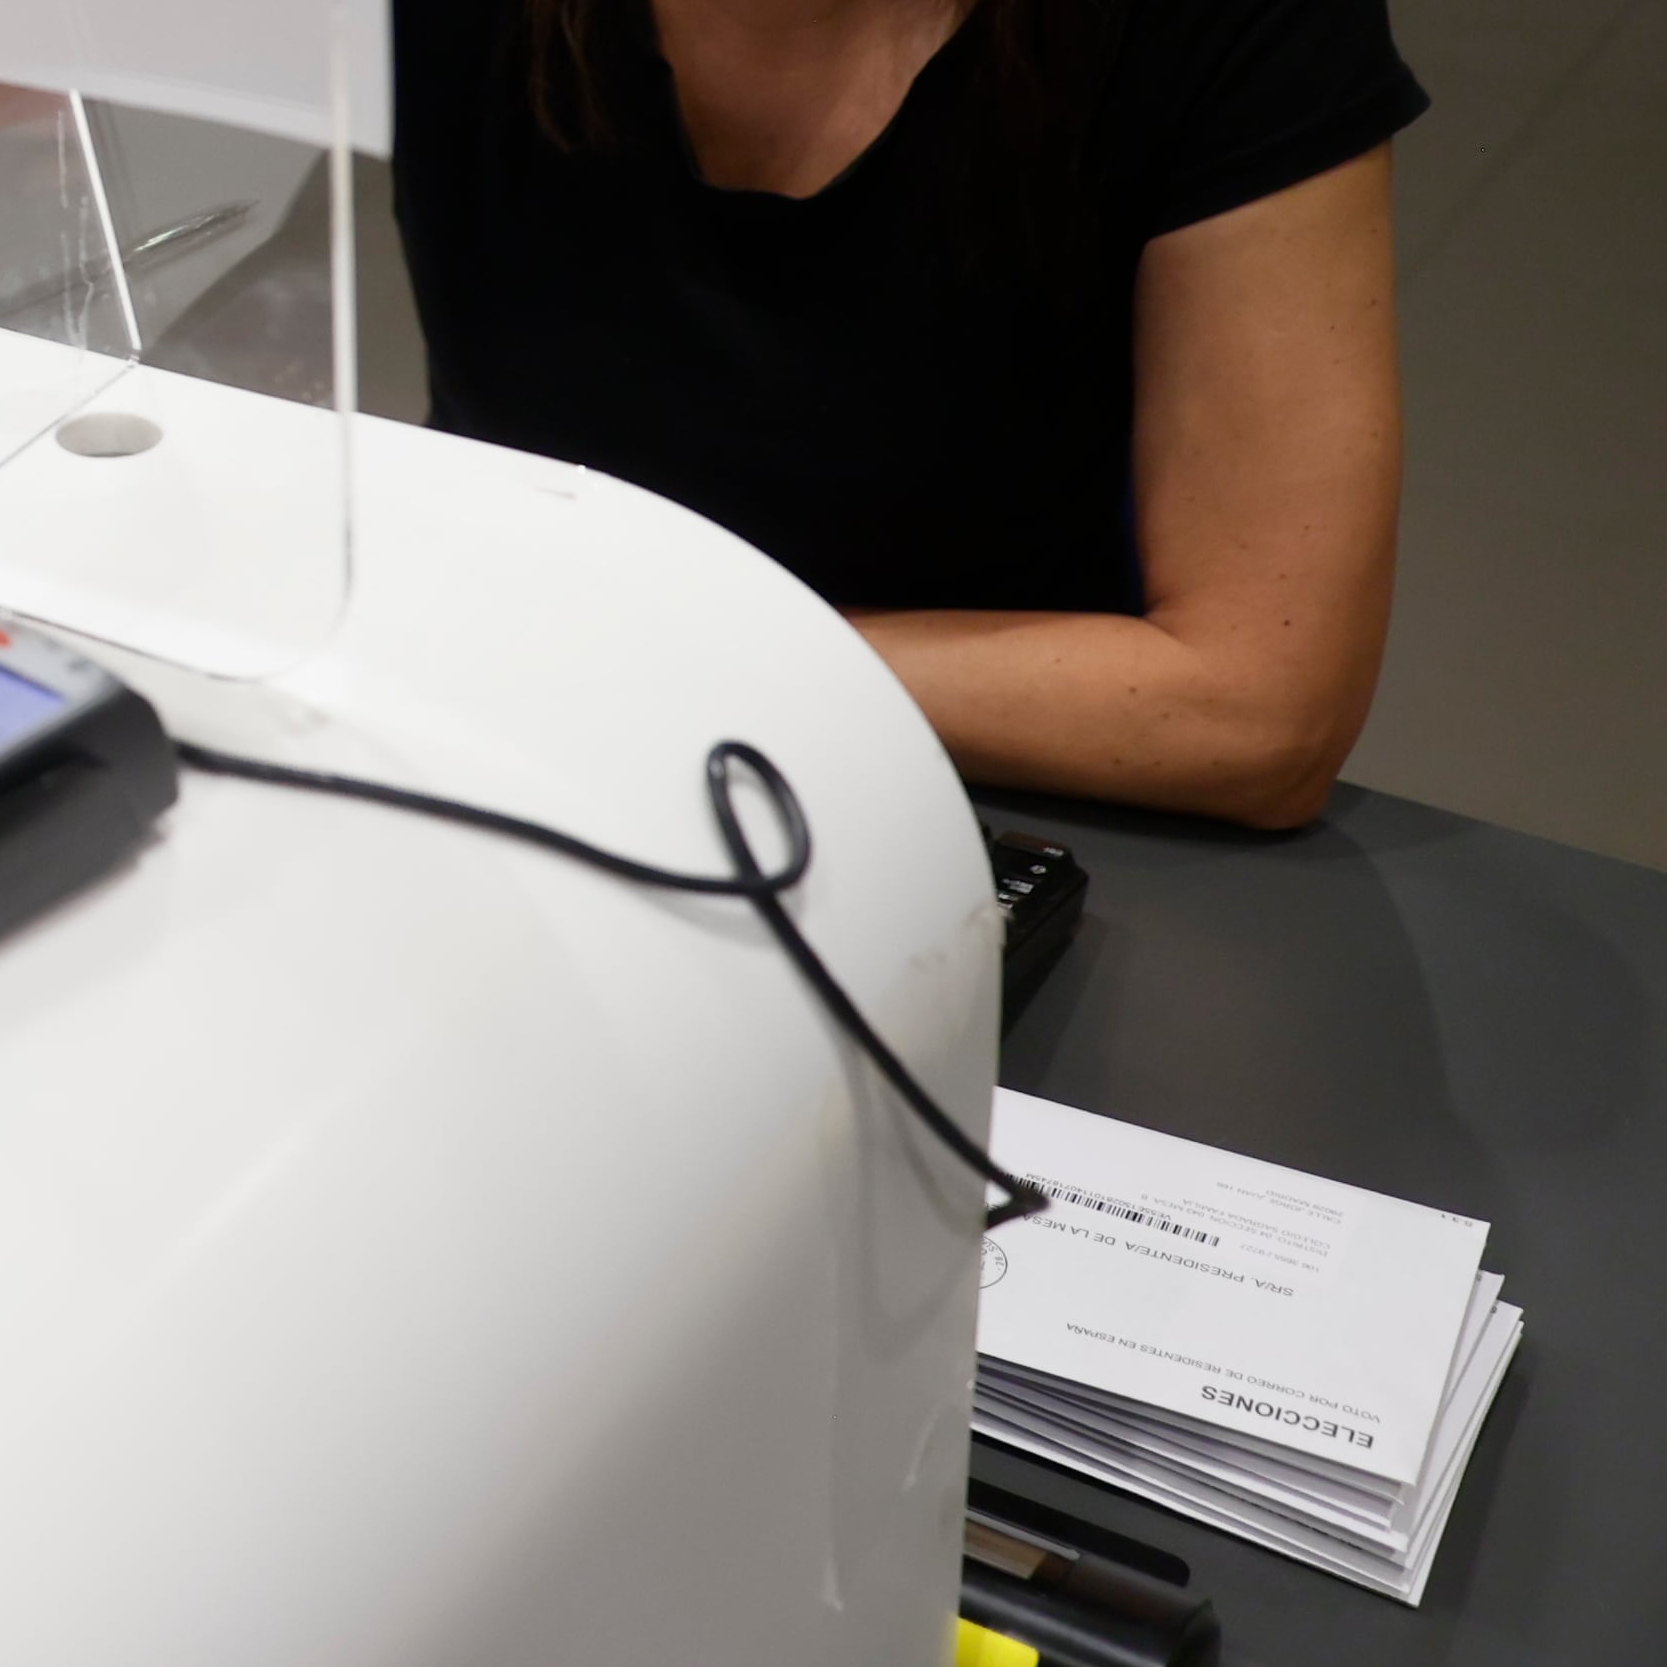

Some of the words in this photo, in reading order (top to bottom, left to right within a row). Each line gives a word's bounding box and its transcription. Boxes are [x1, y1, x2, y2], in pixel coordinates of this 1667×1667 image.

[1022, 1215, 1065, 1234] MESA
[1070, 1225, 1090, 1240] LA
[1094, 1233, 1116, 1247] DE
[1124, 1240, 1245, 1284] PRESIDENTE/A
[1251, 1278, 1295, 1297] SR/A.
[1066, 1321, 1116, 1344] ESPAÑA
[1118, 1337, 1137, 1349] EN
[1139, 1343, 1222, 1375] RESIDENTES
[1226, 1370, 1244, 1381] DE
[1246, 1375, 1305, 1399] CORREO
[1308, 1393, 1339, 1411] POR
[1201, 1385, 1375, 1449] ELECCIONES
[1342, 1403, 1381, 1424] VOTO
